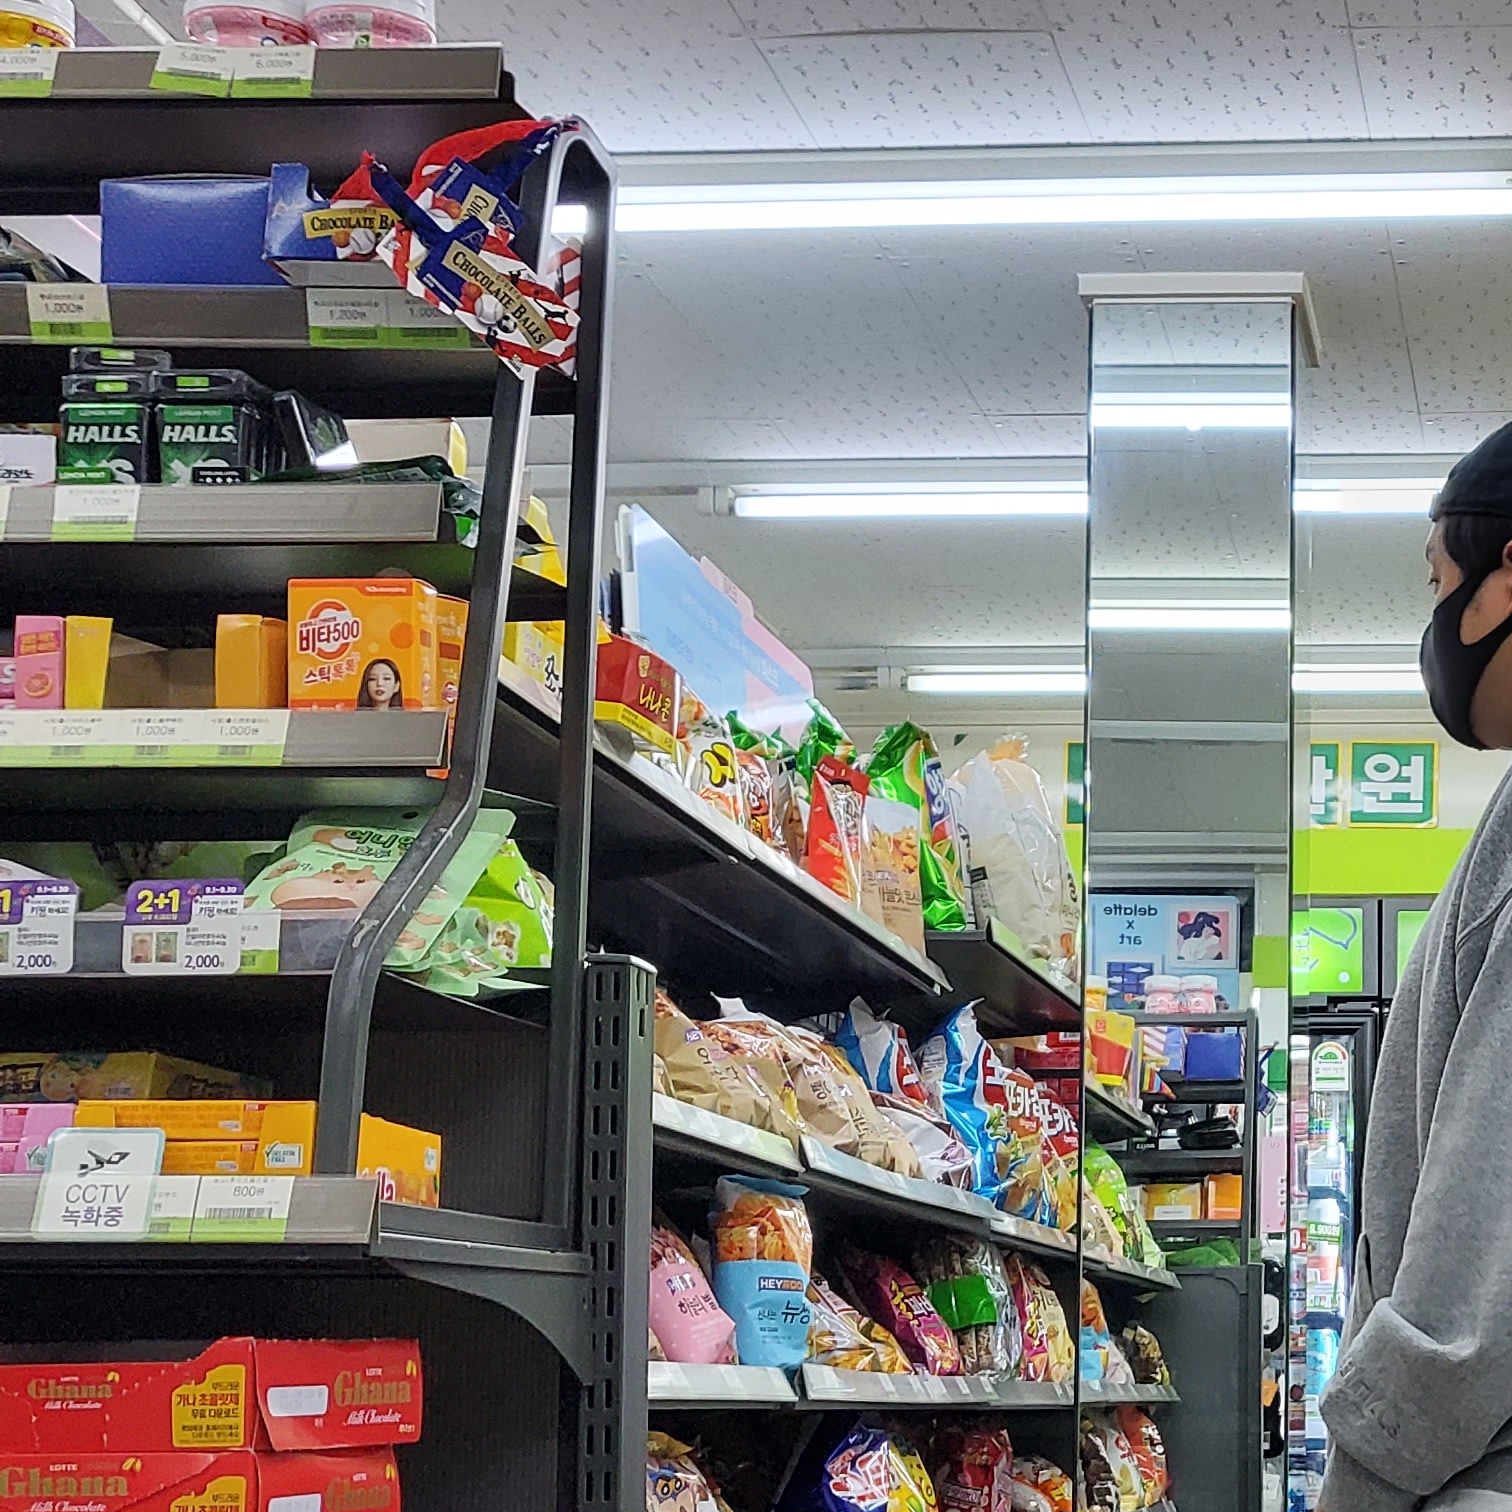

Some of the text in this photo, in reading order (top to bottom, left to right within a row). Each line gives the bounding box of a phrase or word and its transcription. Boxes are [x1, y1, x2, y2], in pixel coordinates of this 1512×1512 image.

[309, 214, 376, 232] CHOCOLATE
[452, 251, 548, 346] CHOCOLATE BALLS
[66, 425, 142, 444] HALLS
[162, 425, 238, 444] HALLS
[137, 889, 181, 914] 2+1
[65, 1183, 129, 1203] CCTV
[232, 1185, 265, 1198] 800원
[61, 1206, 125, 1228] 녹화중
[27, 1378, 113, 1399] Ghana
[334, 1370, 412, 1408] Ghana
[62, 1400, 103, 1410] Chocolate
[176, 1393, 197, 1406] 가나
[364, 1407, 402, 1424] Chocolate
[49, 1463, 79, 1472] LOTTE
[0, 1466, 129, 1499] Ghana
[54, 1501, 107, 1512] Chocolate
